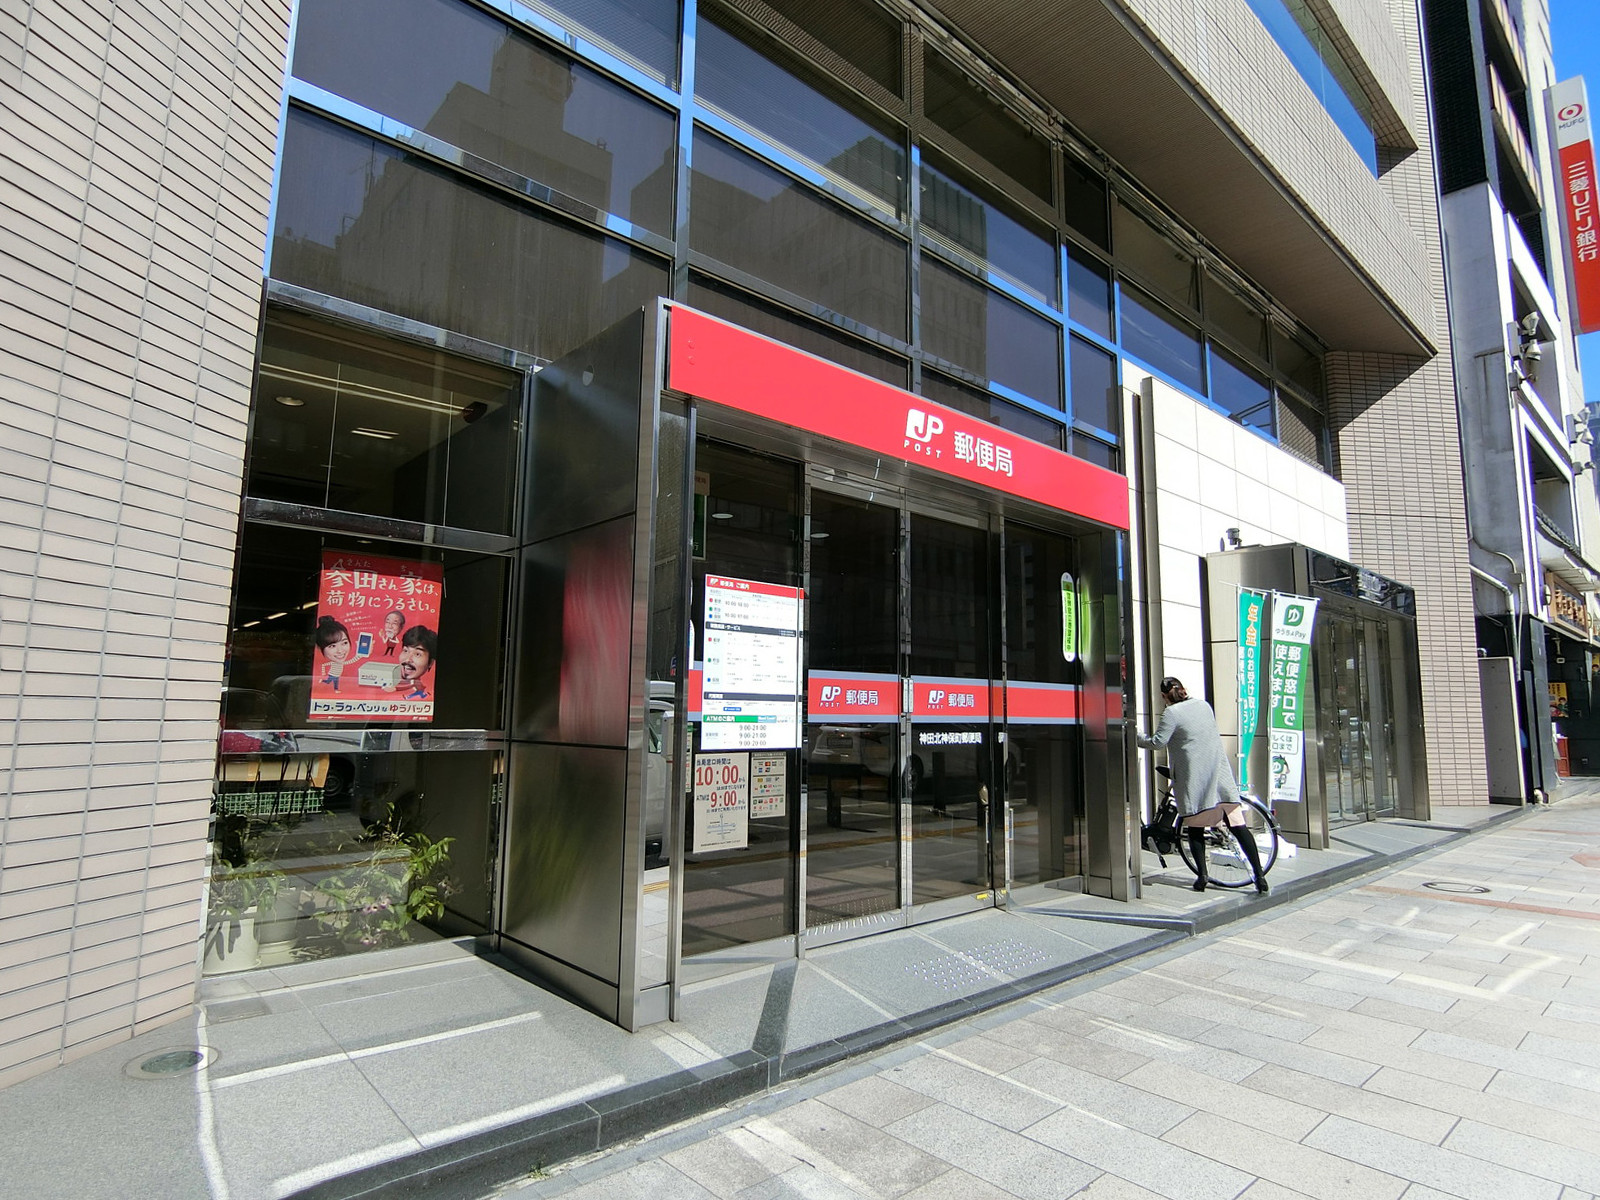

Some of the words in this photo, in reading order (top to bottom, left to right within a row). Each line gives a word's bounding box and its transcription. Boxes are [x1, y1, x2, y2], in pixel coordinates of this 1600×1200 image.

[1558, 117, 1585, 130] MUFG
[1568, 160, 1598, 262] 三菱UFJ銀行
[905, 408, 944, 443] JP
[904, 439, 941, 459] POST
[954, 431, 1013, 477] 郵便局
[325, 559, 438, 596] 参田さん家は、
[326, 590, 436, 614] 荷物にうるさい。
[1275, 628, 1306, 640] ゆうちょPay
[1272, 644, 1288, 709] 使えます
[1282, 645, 1302, 727] 郵便窓口で
[846, 689, 878, 706] 郵便局
[948, 693, 975, 708] 郵便局
[919, 732, 982, 745] 神田北神保町郵便局
[1272, 742, 1293, 751] 口まで
[1273, 734, 1293, 743] しくは
[696, 765, 739, 786] 10:00
[711, 790, 737, 808] 9:00
